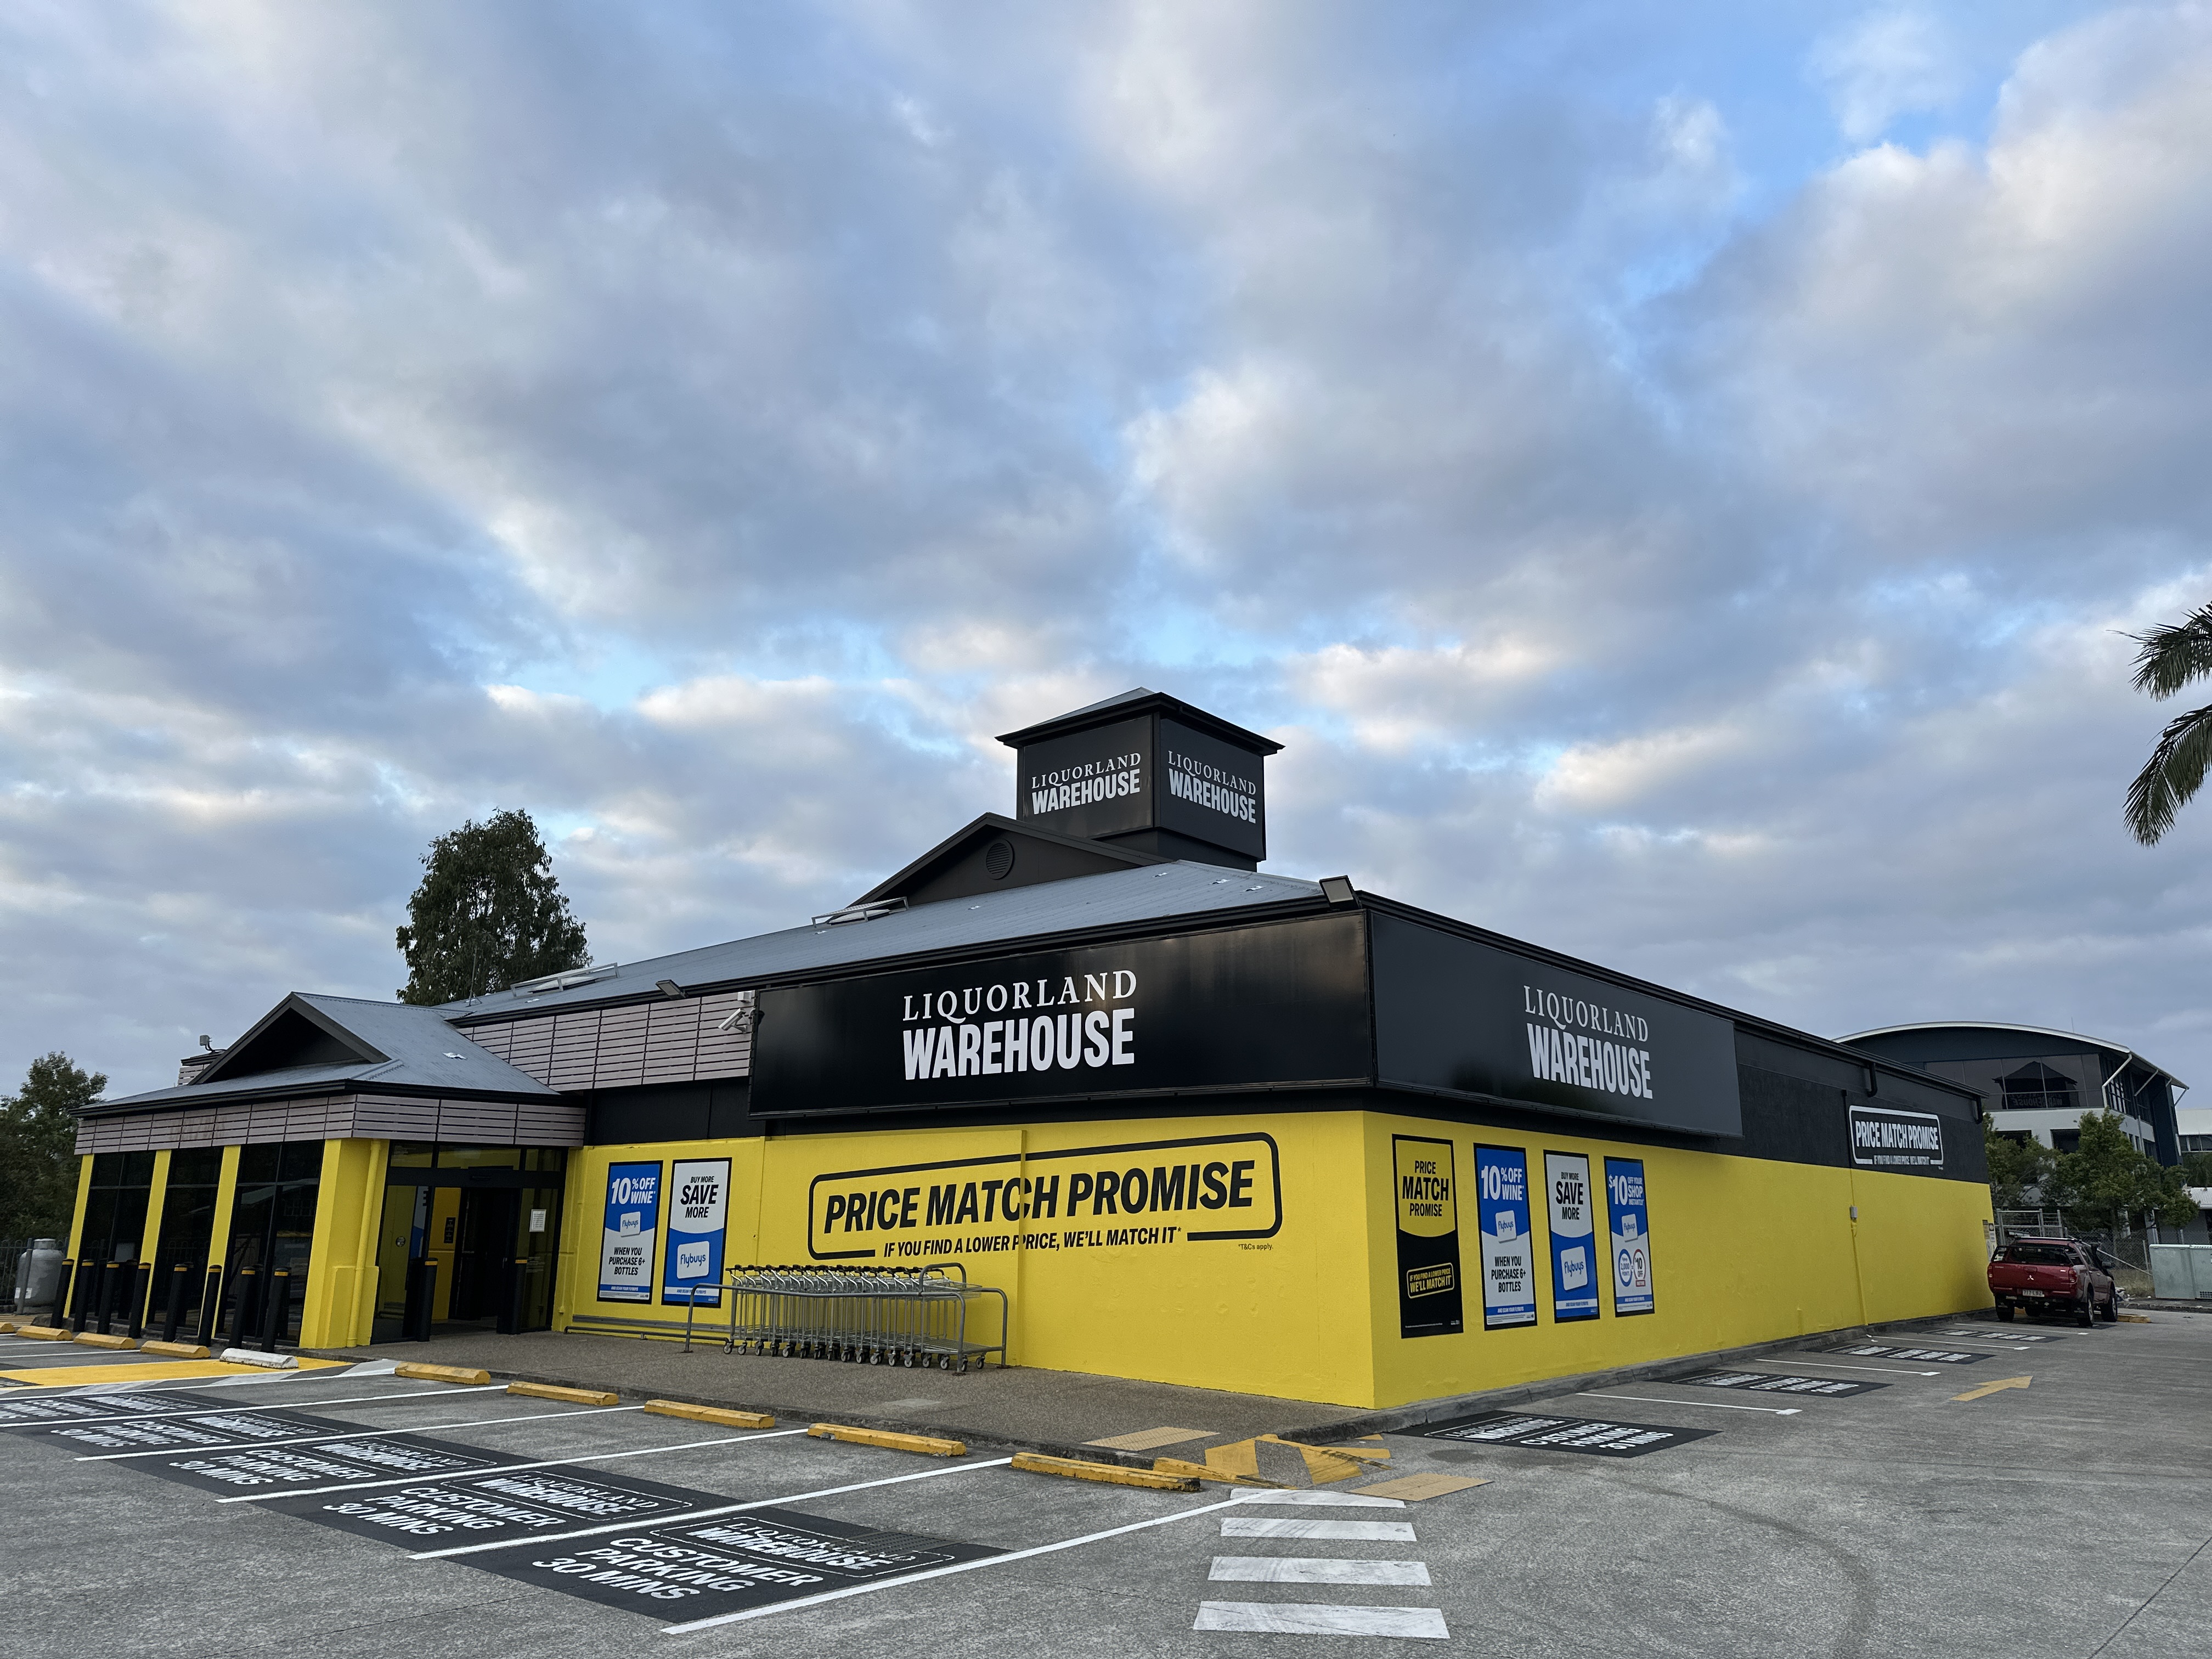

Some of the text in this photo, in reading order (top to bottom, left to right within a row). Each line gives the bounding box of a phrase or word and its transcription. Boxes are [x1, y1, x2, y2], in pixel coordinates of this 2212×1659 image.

[1032, 752, 1141, 789] LIQUORLAND
[1168, 751, 1256, 795] LIQUORLAND
[1032, 769, 1141, 815] WAREHOUSE
[1169, 768, 1256, 824] WAREHOUSE
[902, 969, 1137, 1024] LIQUORLAND
[1523, 985, 1649, 1042] LIQUORLAND
[902, 1007, 1135, 1080] WAREHOUSE
[1527, 1023, 1653, 1099] WAREHOUSE
[1855, 1121, 1939, 1150] PRICE MATCH PROMISE
[1414, 1160, 1436, 1175] PRICE
[1508, 1167, 1522, 1183] OFF
[639, 1177, 656, 1190] OFF
[680, 1184, 719, 1205] SAVE
[824, 1160, 1255, 1234] PRICE MATCH PROMISE
[1402, 1176, 1449, 1201] MATCH
[1555, 1181, 1583, 1205] SAVE
[1628, 1184, 1643, 1198] SHOP
[685, 1207, 709, 1218] MORE
[1409, 1203, 1442, 1217] PROMISE
[1562, 1207, 1579, 1220] MORE
[884, 1242, 895, 1257] IF
[898, 1240, 922, 1257] YOU
[923, 1239, 952, 1255] FIND
[953, 1238, 963, 1254] A
[965, 1235, 1010, 1253] LOWER
[1064, 1230, 1103, 1248] WE'LL
[1106, 1227, 1159, 1246] MATCH
[608, 1257, 638, 1266] PURCHASE
[614, 1267, 638, 1276] BOTTLES
[1491, 1268, 1519, 1280] PURCHASE
[1494, 1256, 1521, 1267] WHEN YOU
[1410, 1280, 1426, 1293] WE'LL
[1426, 1276, 1445, 1289] MATCH
[1498, 1282, 1521, 1293] BOTTLES
[169, 1460, 273, 1485] 30 MINS
[209, 1455, 321, 1481] PARKING
[245, 1450, 376, 1479] CUSTOMER
[471, 1479, 636, 1515] WAREHOUSE
[511, 1475, 659, 1508] LIQUORLAND
[323, 1503, 453, 1534] 30 MINS
[364, 1495, 505, 1529] PARKING
[400, 1487, 566, 1527] CUSTOMER
[610, 1538, 823, 1585] CUSTOMER
[686, 1527, 893, 1570] WAREHOUSE
[532, 1558, 700, 1599] 30 MINS
[574, 1548, 755, 1591] PARKING
